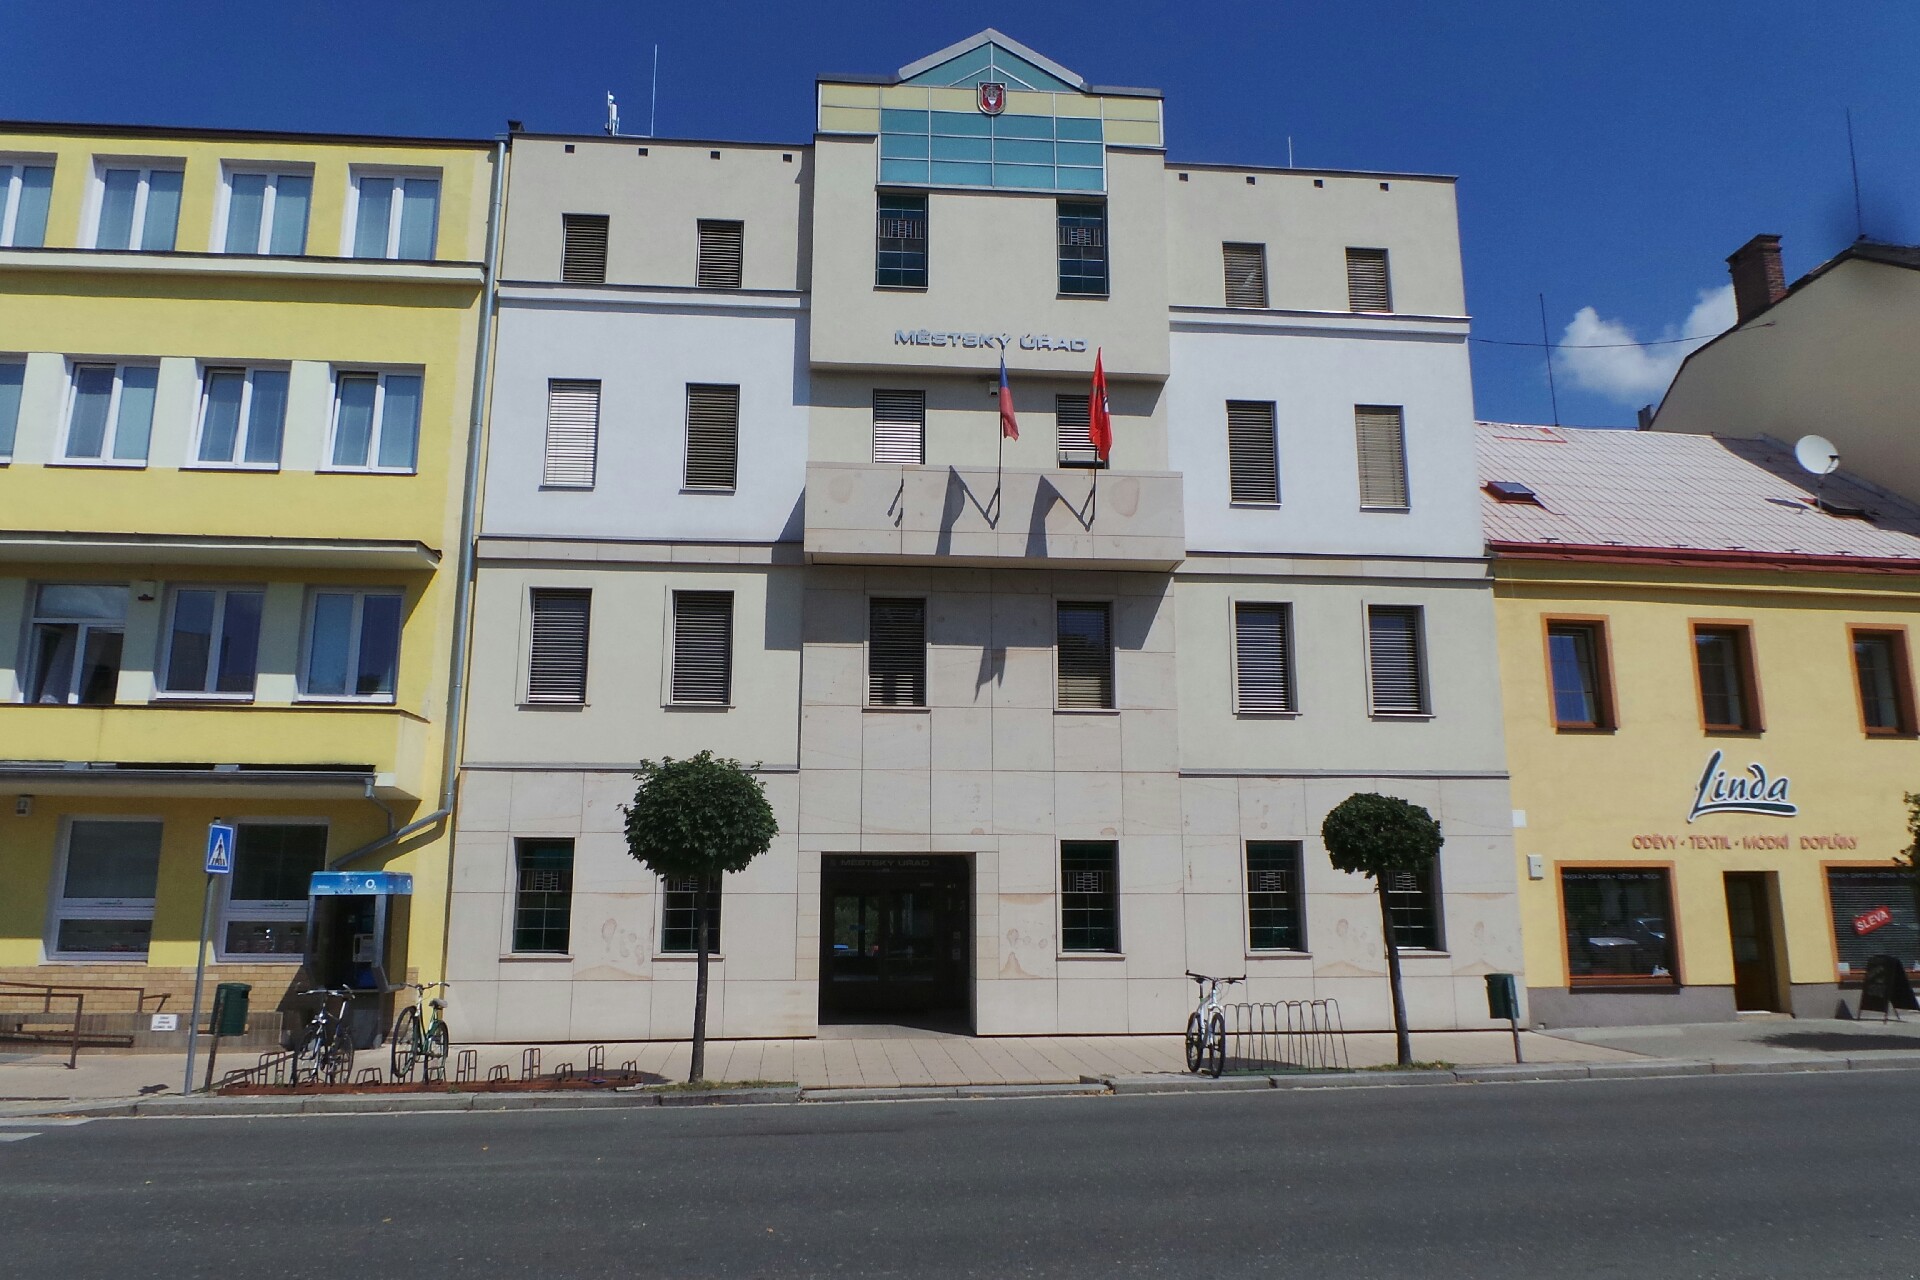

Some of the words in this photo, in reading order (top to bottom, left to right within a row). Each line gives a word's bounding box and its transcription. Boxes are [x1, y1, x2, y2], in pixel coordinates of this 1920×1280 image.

[894, 328, 1012, 349] MĚSTSKÝ
[1019, 333, 1089, 353] ÚŘAD
[1687, 749, 1798, 823] Linda
[1632, 833, 1678, 850] ODĚVY
[1688, 834, 1732, 850] TEXTIL
[1855, 910, 1889, 931] SLEVA
